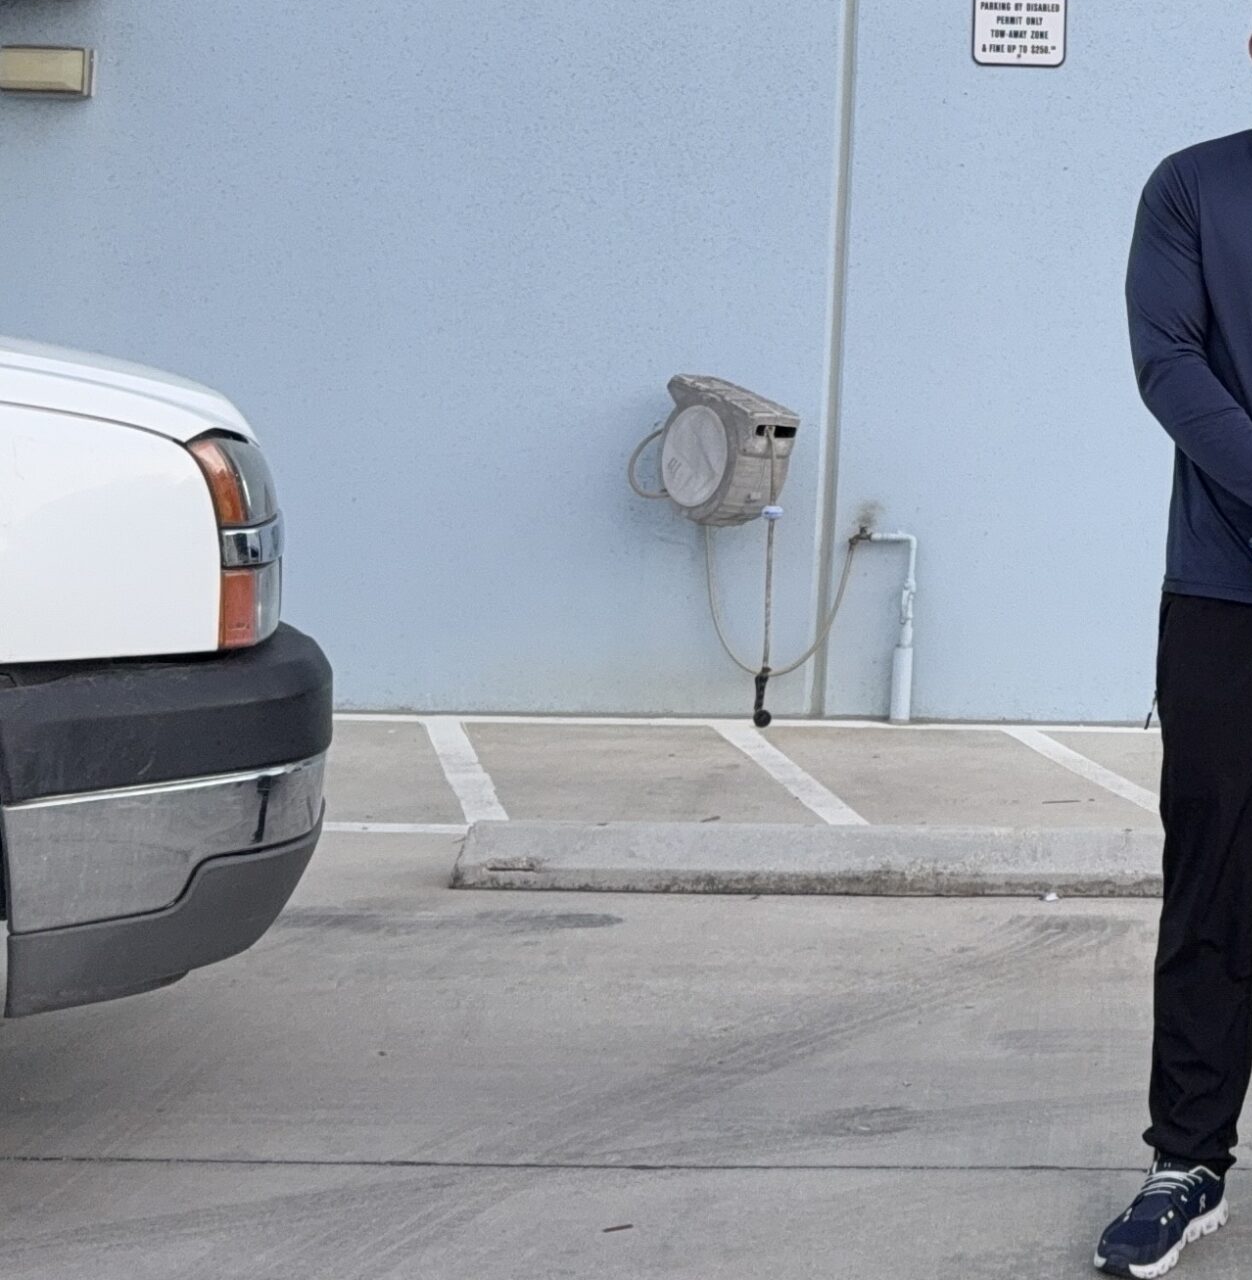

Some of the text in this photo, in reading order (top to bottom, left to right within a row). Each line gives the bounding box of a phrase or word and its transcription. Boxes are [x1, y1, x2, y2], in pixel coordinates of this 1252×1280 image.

[980, 1, 1060, 13] PARKING BY DISABLED
[996, 15, 1043, 26] PERMIT ONLY
[990, 29, 1048, 40] TOW-AWAY ZONE
[981, 44, 987, 53] &
[989, 44, 1004, 53] FINE
[1007, 44, 1016, 54] UP
[1019, 45, 1028, 54] TO
